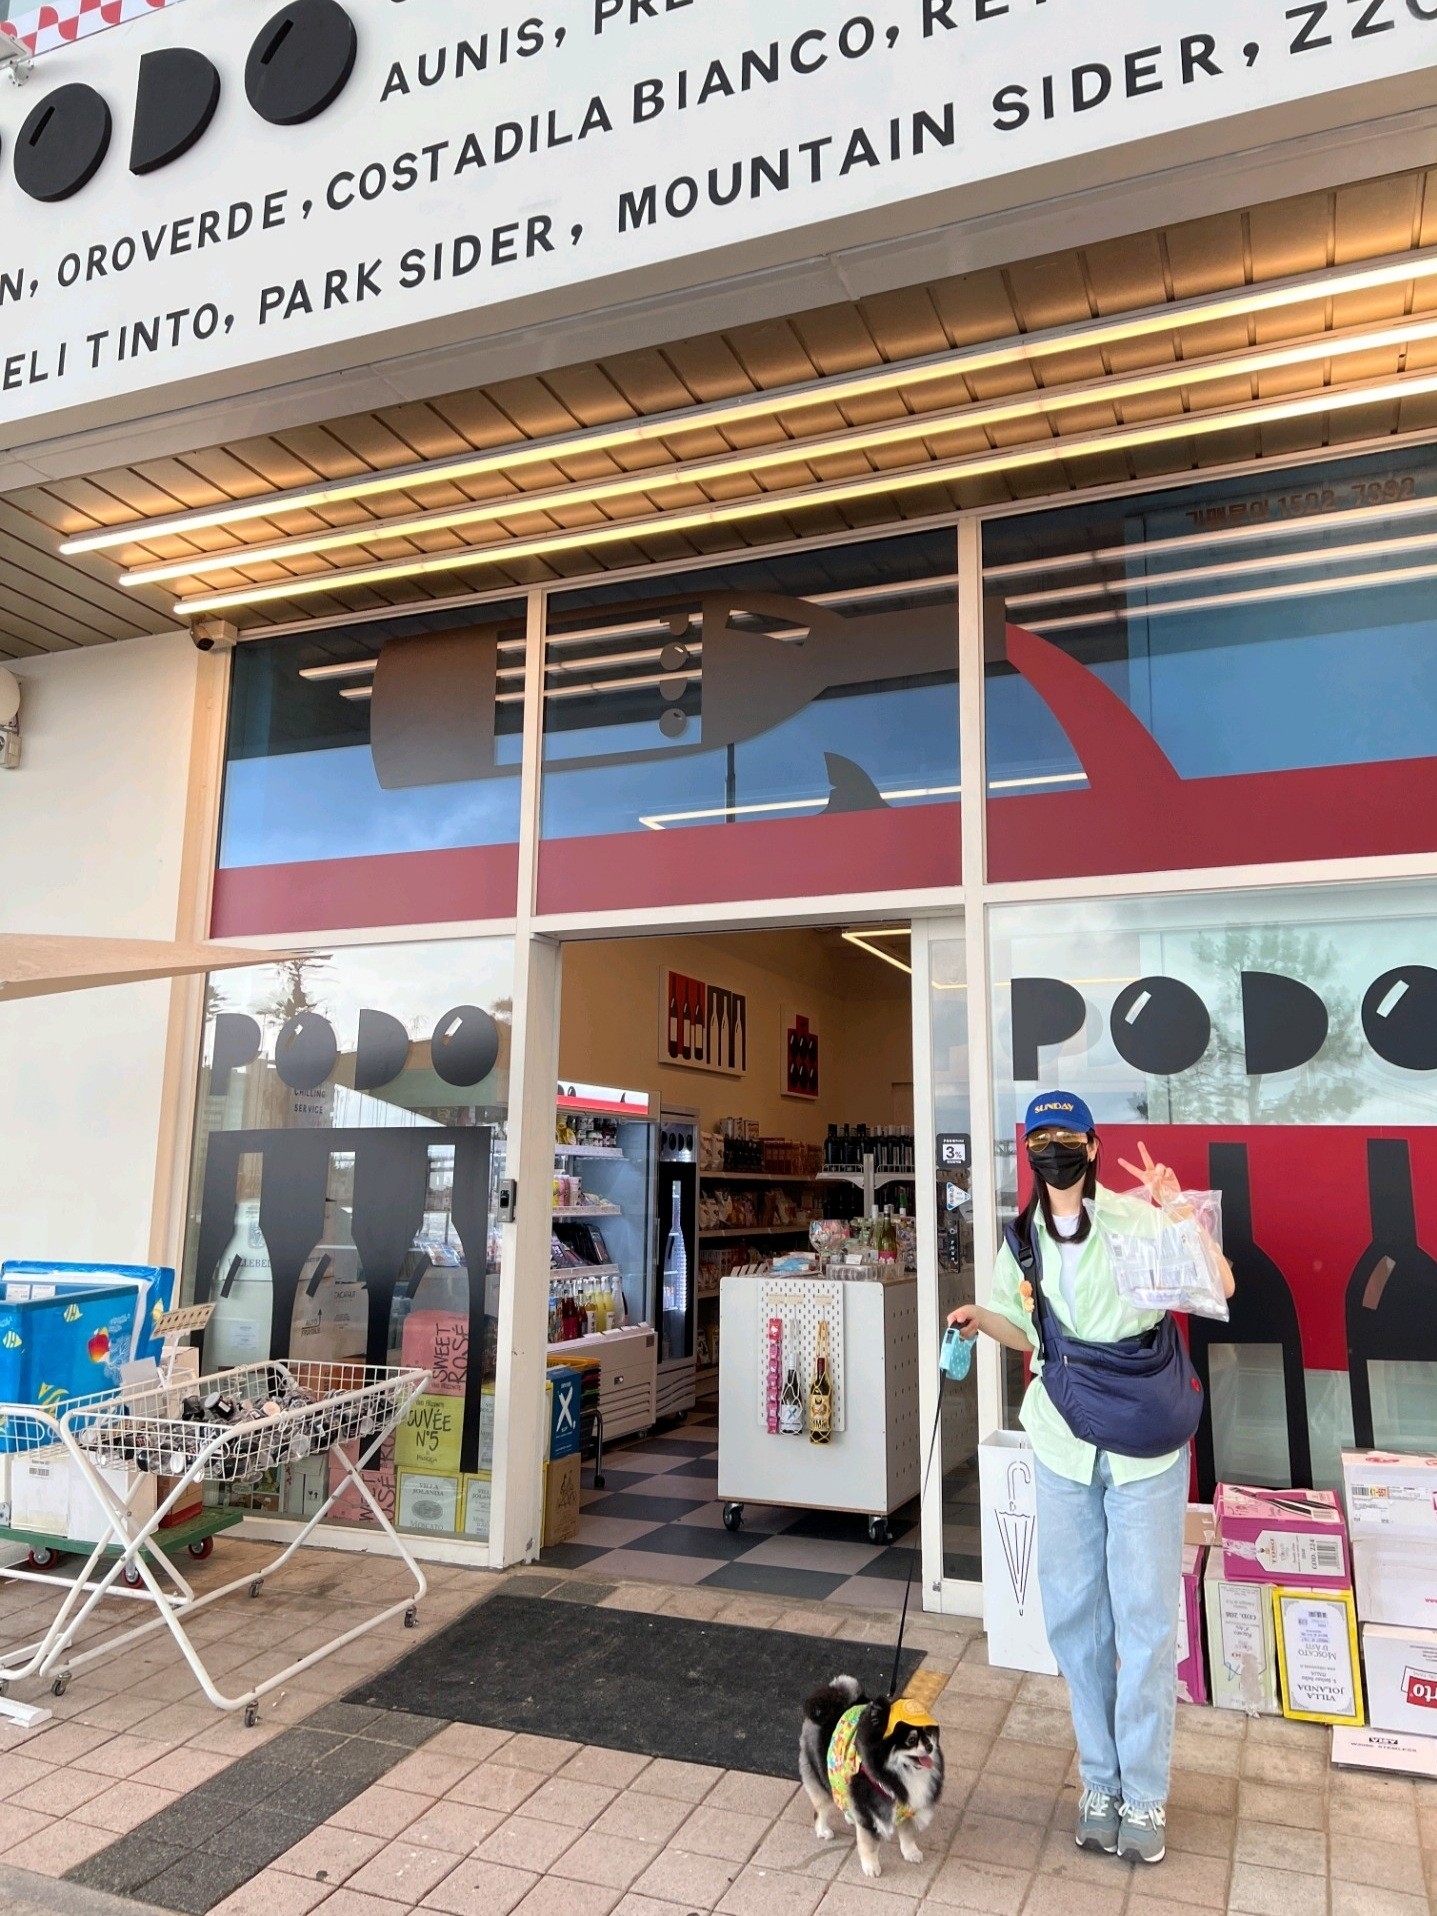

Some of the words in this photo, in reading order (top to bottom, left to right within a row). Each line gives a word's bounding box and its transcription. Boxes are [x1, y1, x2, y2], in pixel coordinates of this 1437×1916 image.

[380, 17, 567, 103] AUNIS,
[327, 96, 613, 211] COSTADILA
[633, 16, 900, 124] BIANCO,
[87, 303, 235, 369] TINTO,
[258, 259, 383, 325] PARK
[400, 215, 583, 287] SIDER,
[618, 103, 955, 232] MOUNTAIN
[209, 1005, 499, 1096] PODO
[1010, 965, 1437, 1081] PODO
[294, 1104, 323, 1114] SERVICE
[1034, 1102, 1075, 1114] SUNDAY
[432, 1322, 452, 1383] SWEET
[1297, 1684, 1345, 1696] JOLANDA
[1307, 1692, 1337, 1702] VILLA
